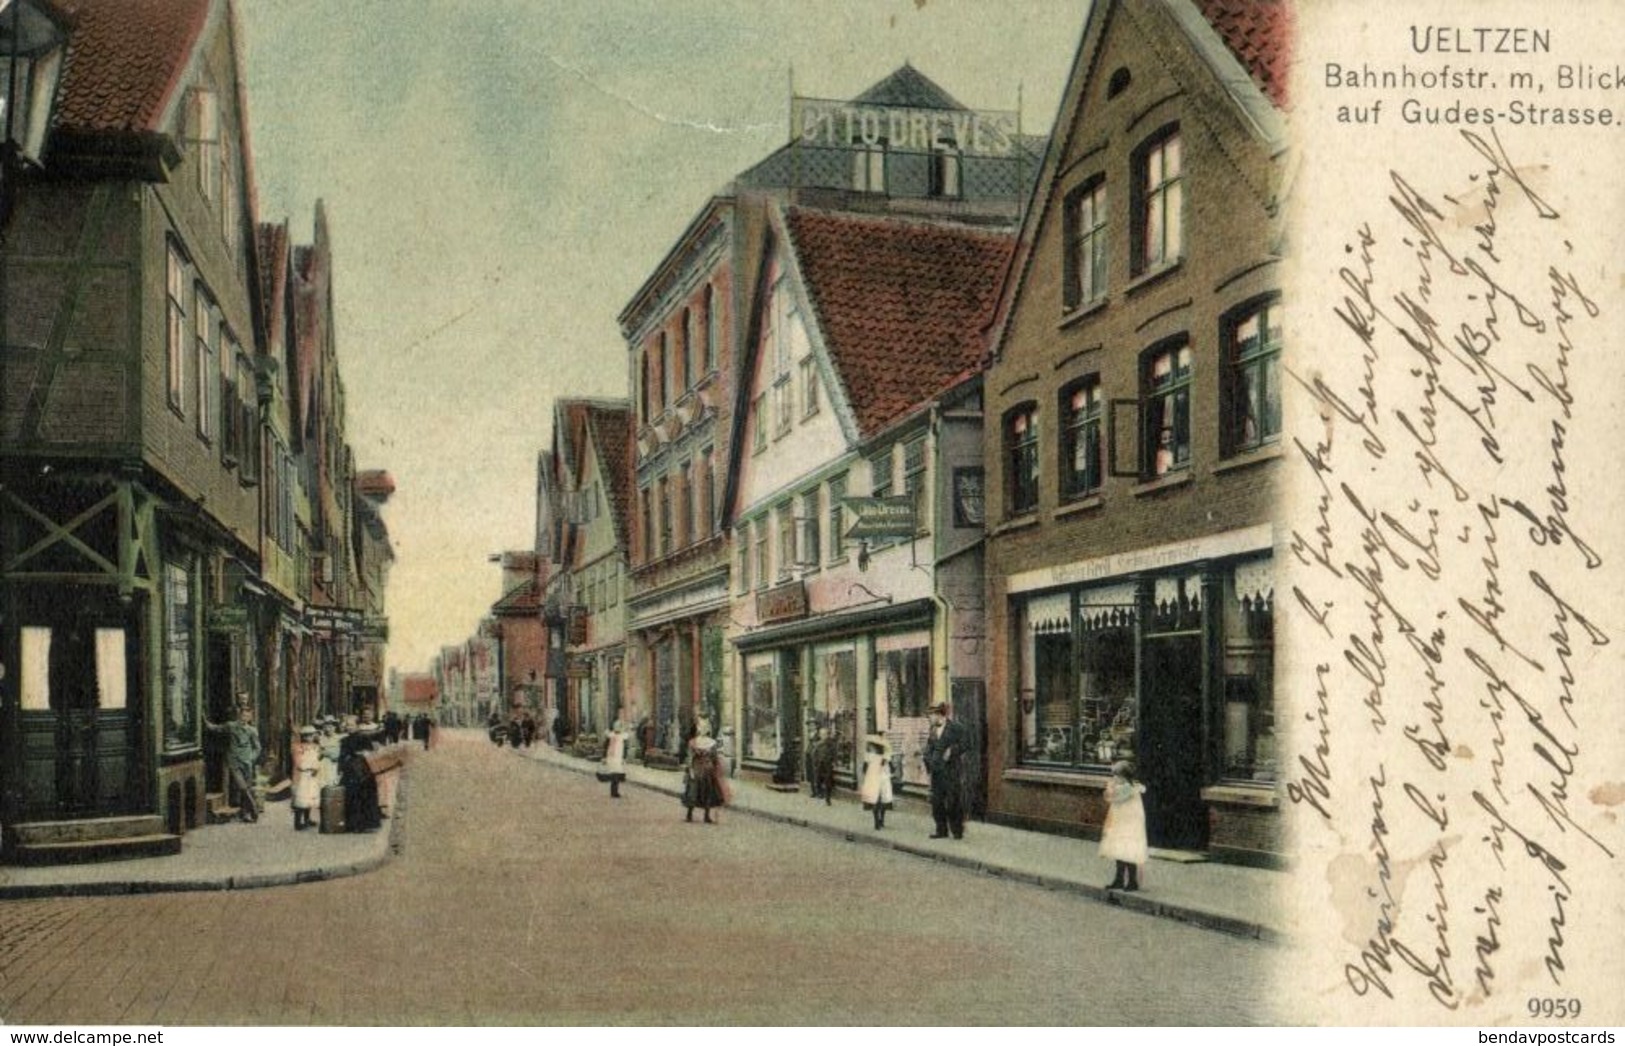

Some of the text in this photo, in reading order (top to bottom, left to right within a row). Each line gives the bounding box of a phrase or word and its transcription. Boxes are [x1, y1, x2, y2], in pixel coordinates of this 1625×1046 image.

[1410, 25, 1551, 53] UELTZEN
[1324, 62, 1497, 89] Bahnhofstr.
[802, 105, 880, 146] OTTO
[1336, 99, 1622, 126] auf Gudes-Strasse.
[1528, 998, 1582, 1018] 9959
